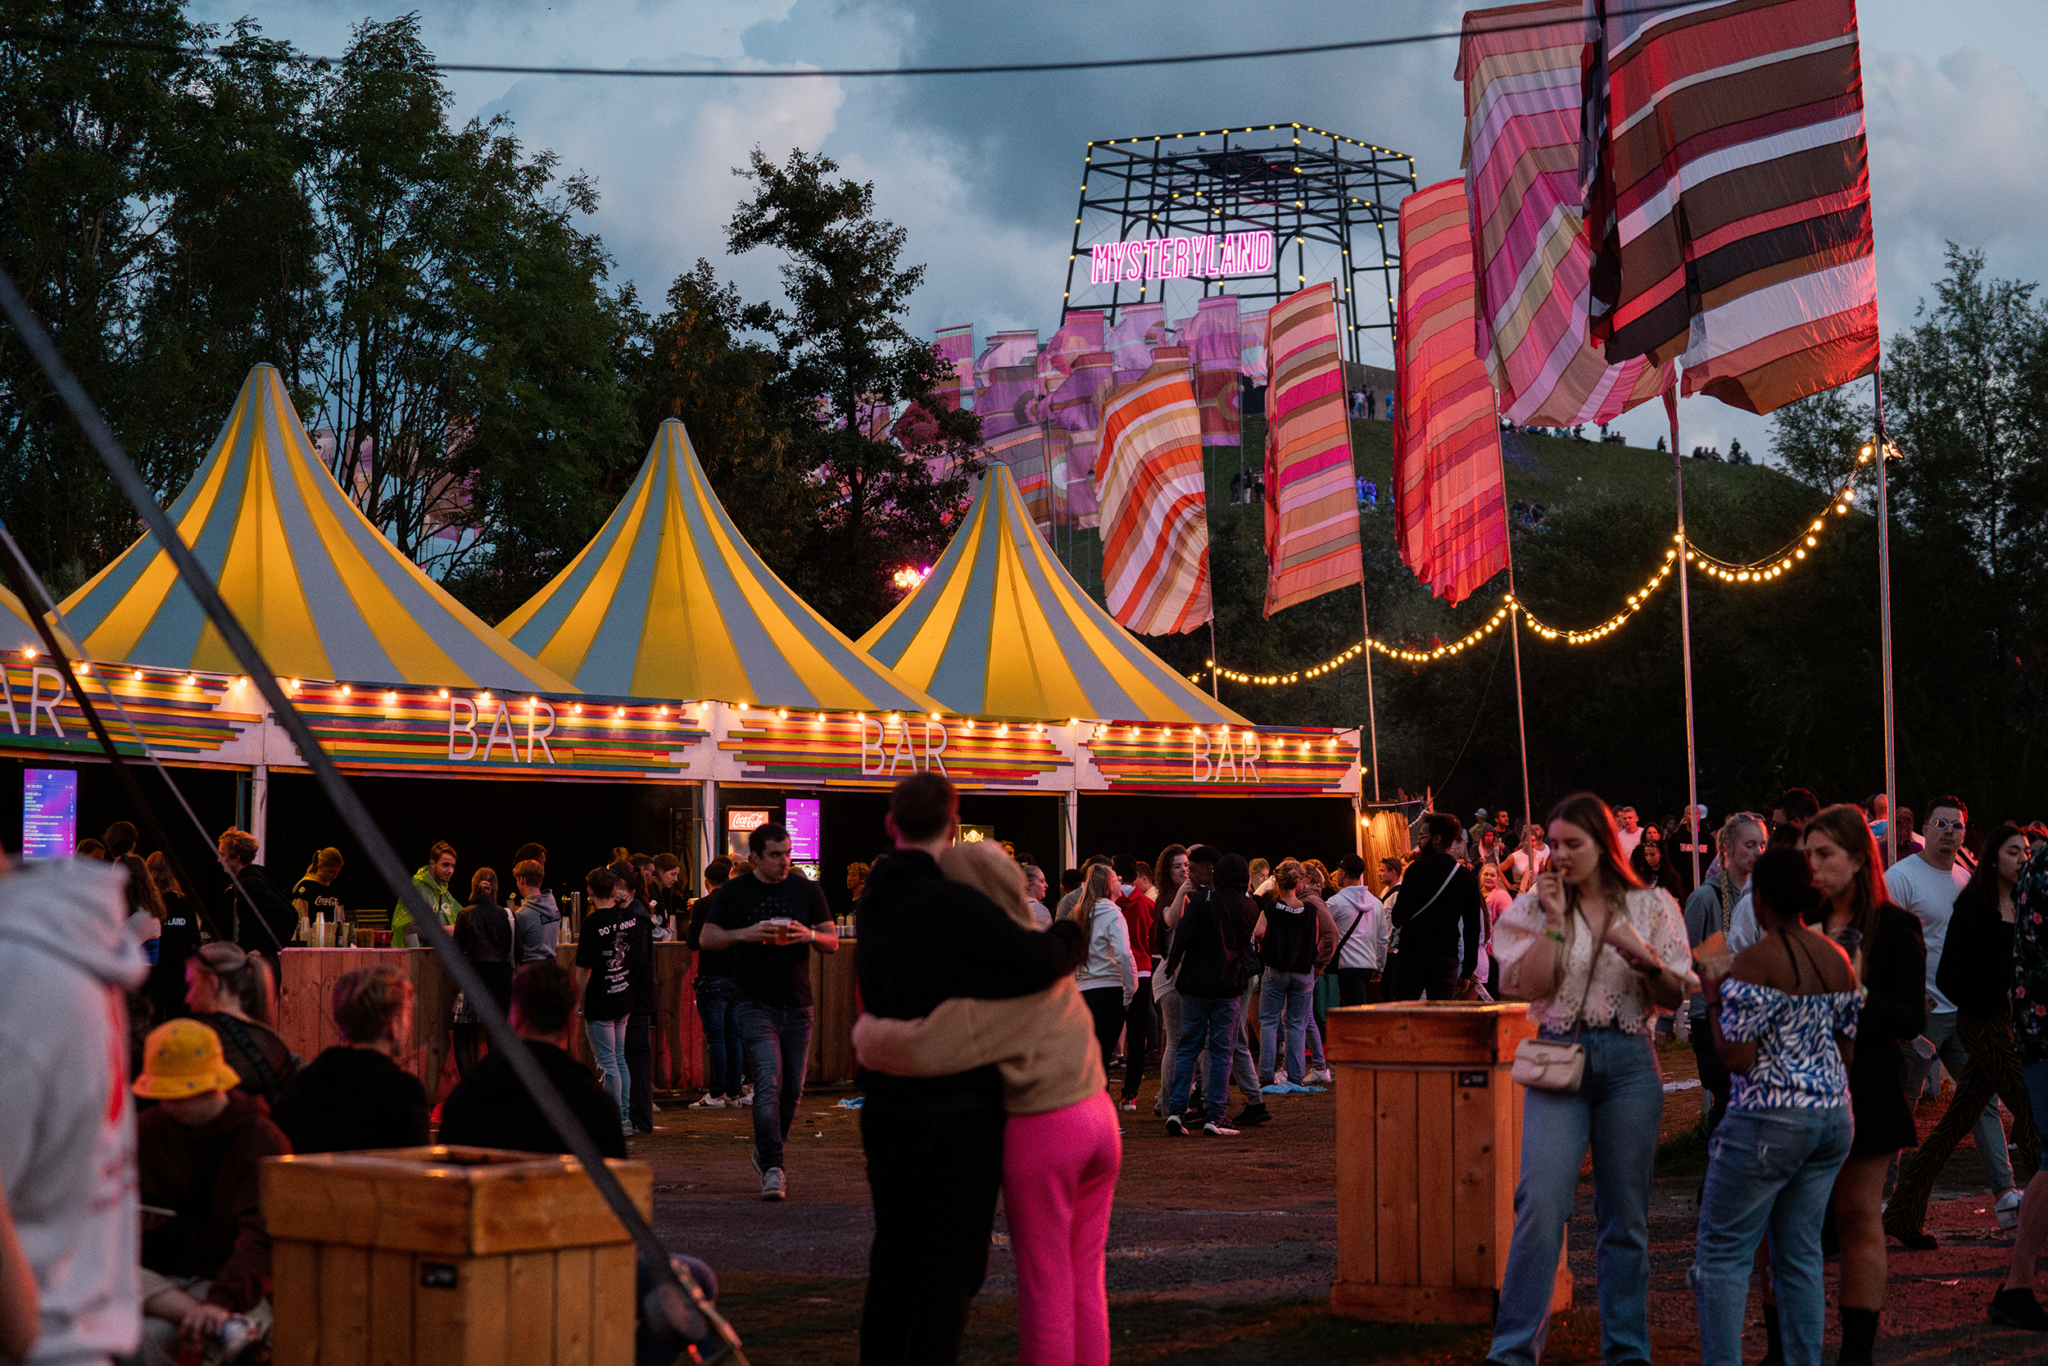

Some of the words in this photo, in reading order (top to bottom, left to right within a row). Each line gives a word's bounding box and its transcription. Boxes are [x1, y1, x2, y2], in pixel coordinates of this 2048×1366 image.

[1091, 231, 1273, 284] MYSTERYLAND
[449, 698, 556, 764] BAR
[862, 719, 948, 778] BAR
[1193, 729, 1261, 783] BAR
